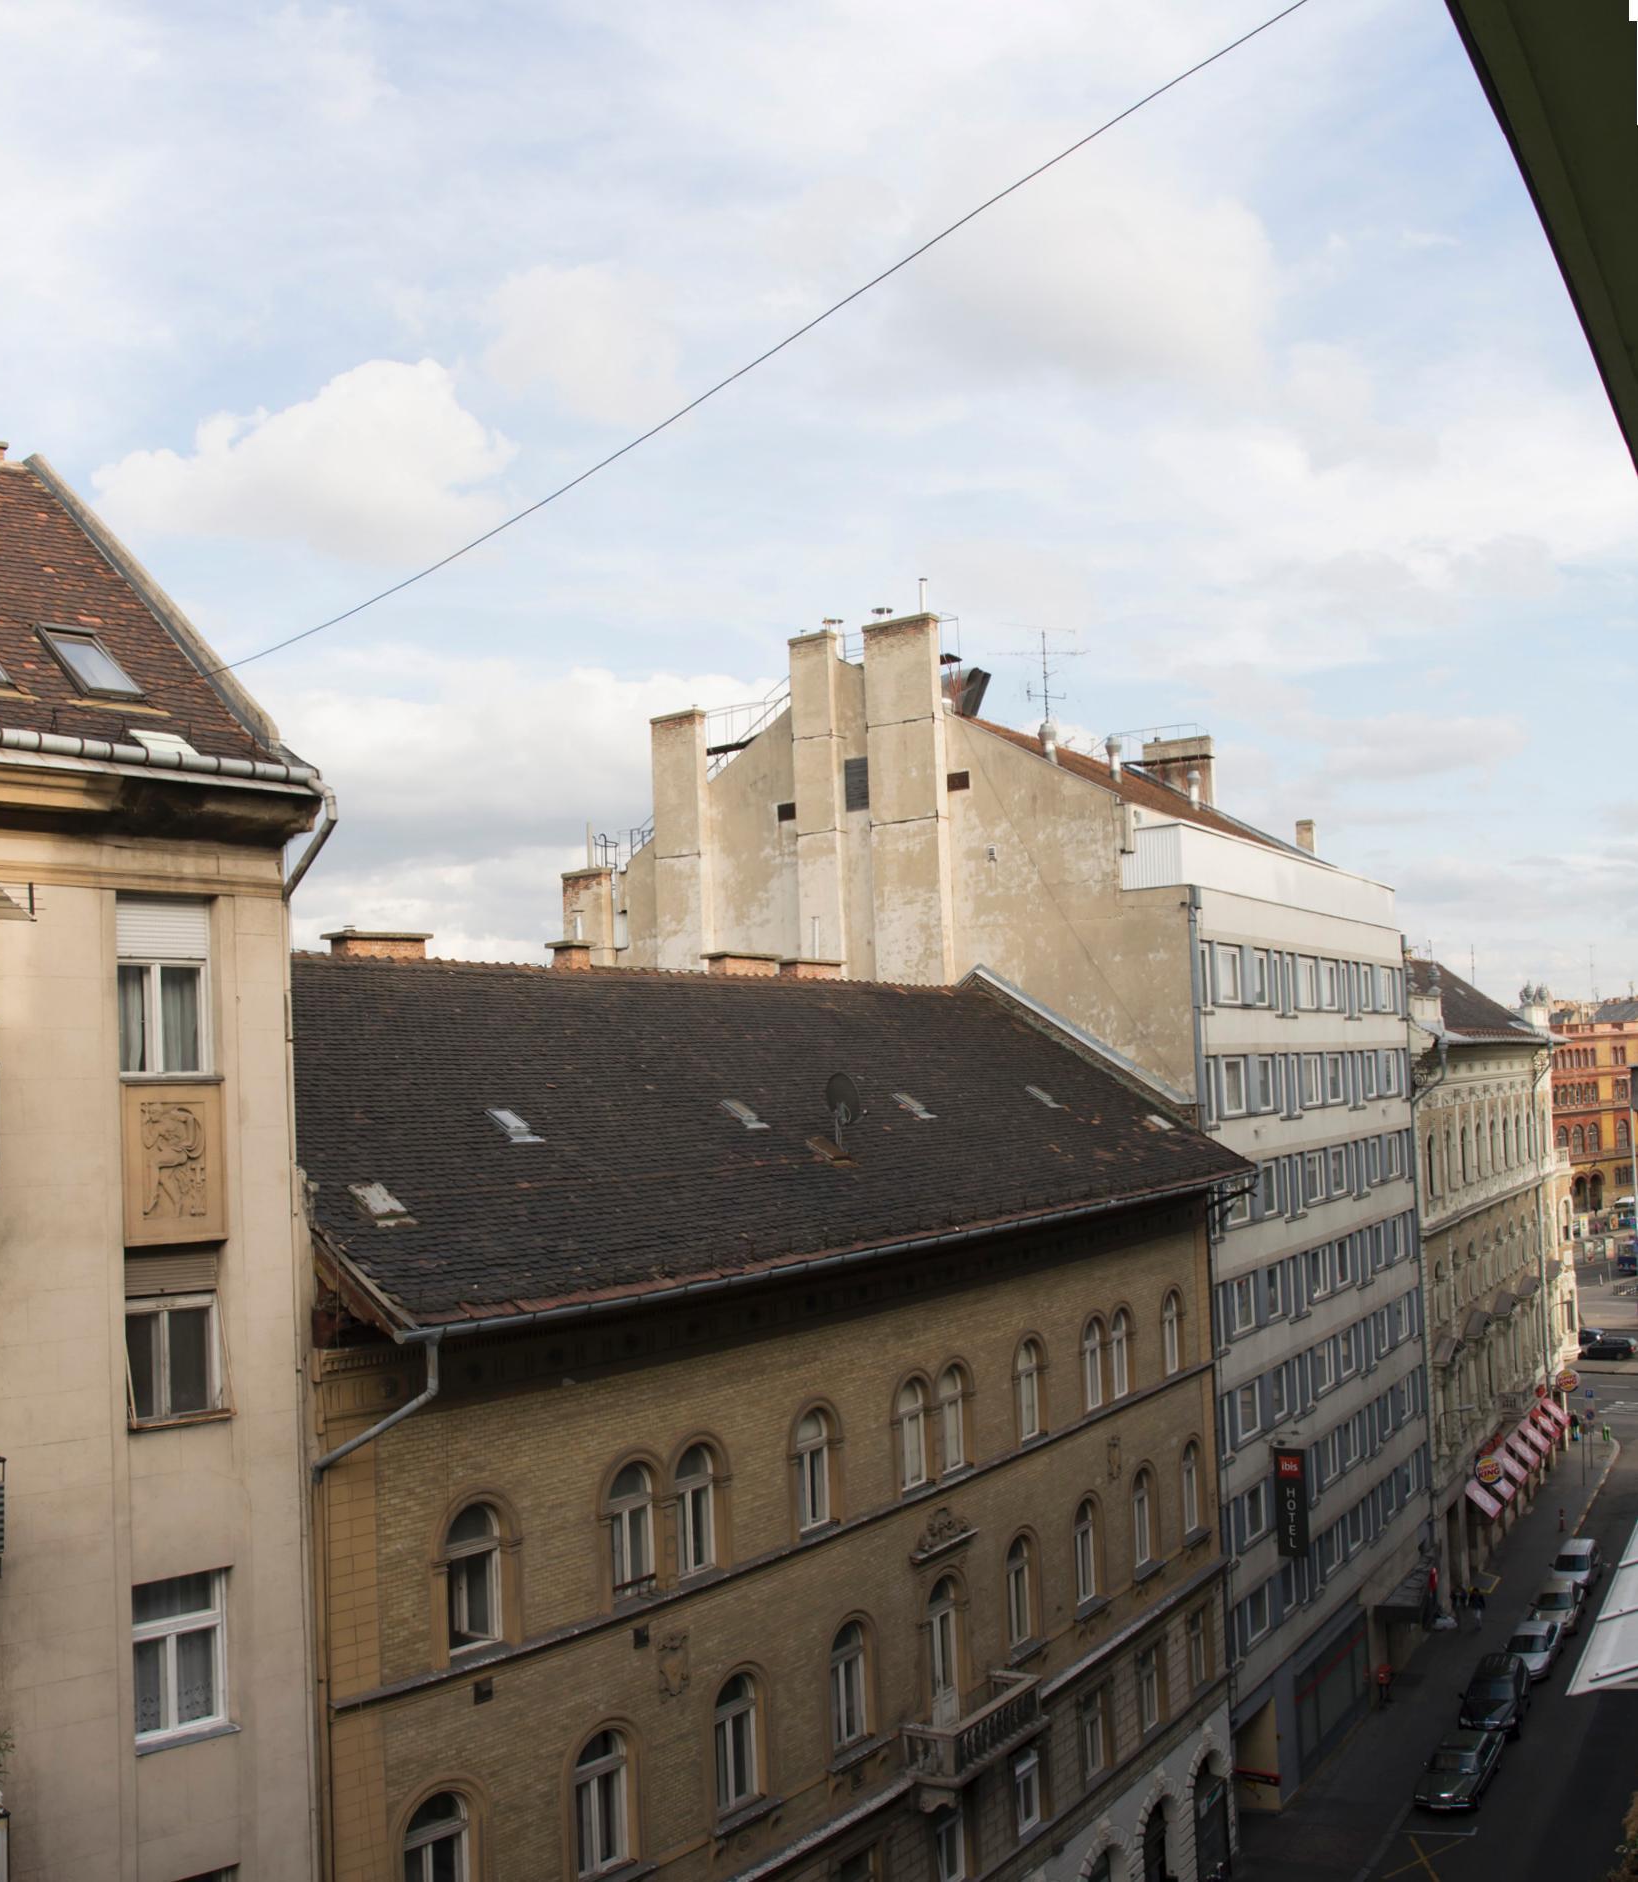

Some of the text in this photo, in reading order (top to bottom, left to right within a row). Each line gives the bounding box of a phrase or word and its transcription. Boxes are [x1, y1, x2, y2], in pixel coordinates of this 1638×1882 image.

[1281, 1461, 1298, 1471] ibis
[1479, 1468, 1500, 1478] KING
[1286, 1488, 1297, 1548] HOTEL
